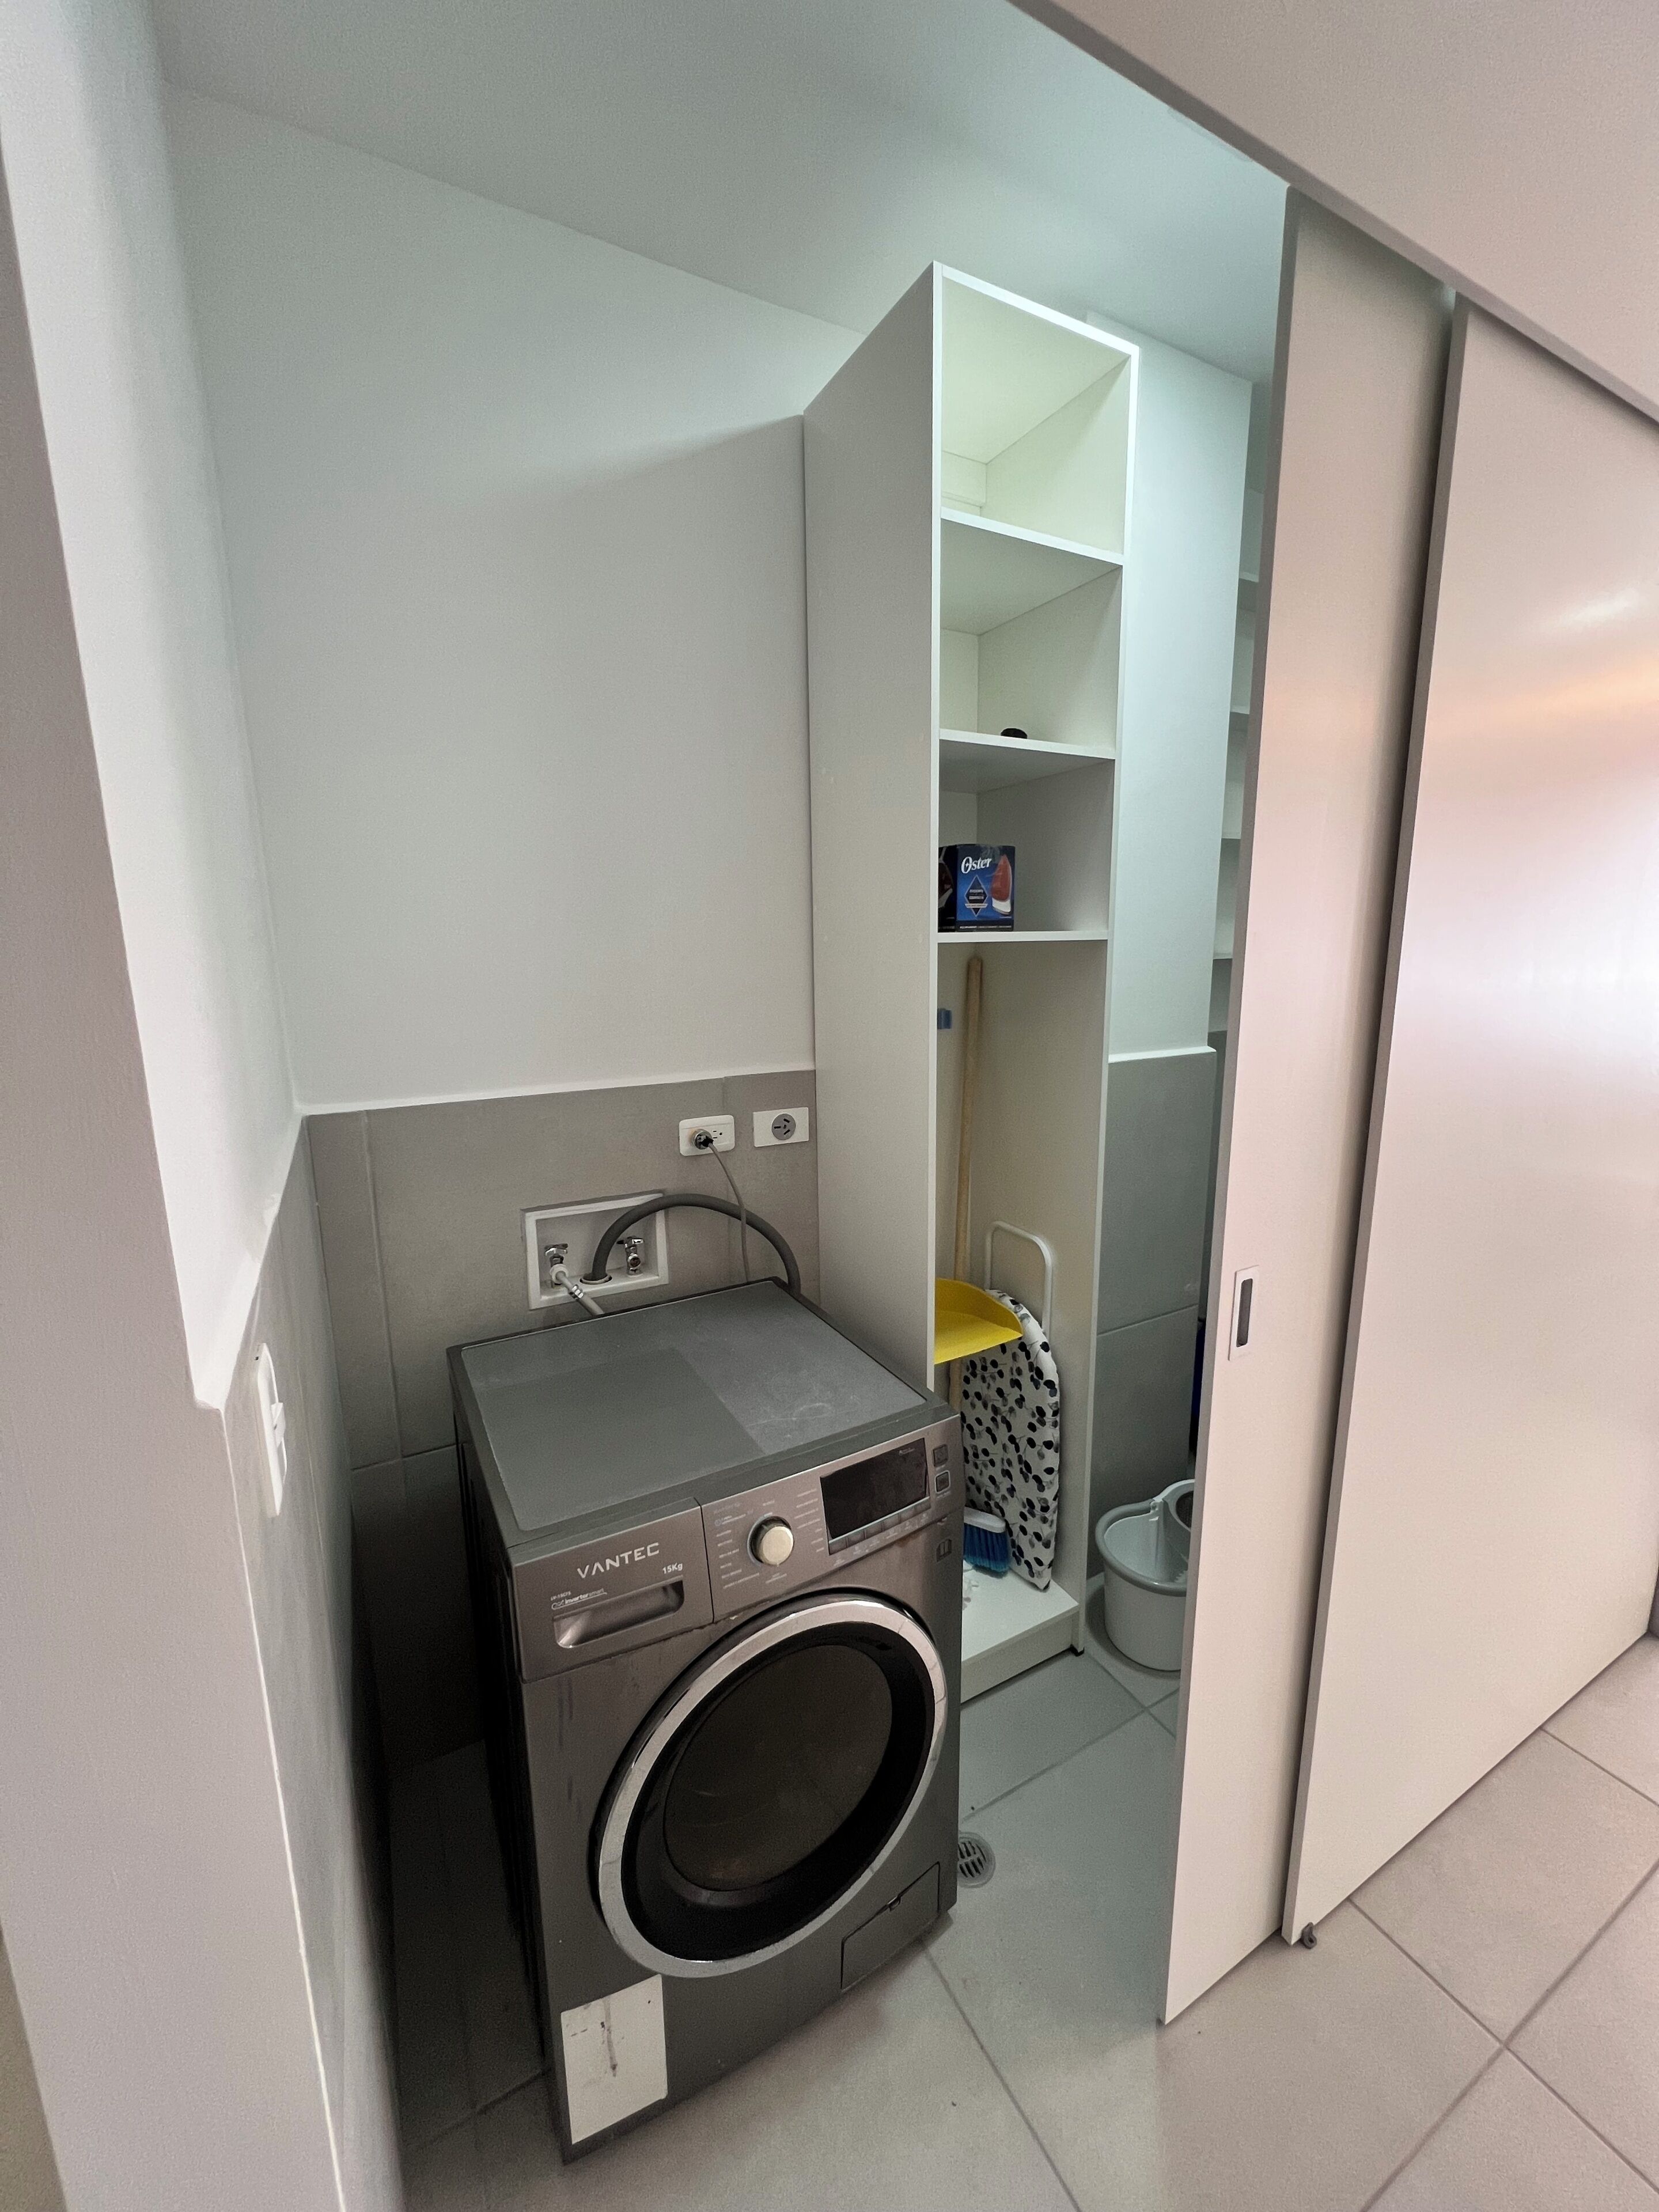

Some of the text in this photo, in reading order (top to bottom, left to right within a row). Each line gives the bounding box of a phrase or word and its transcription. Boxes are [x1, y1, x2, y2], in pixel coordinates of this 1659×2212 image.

[961, 856, 992, 874] Oster
[577, 1542, 660, 1578] VANTEC
[662, 1562, 683, 1574] 15Kg
